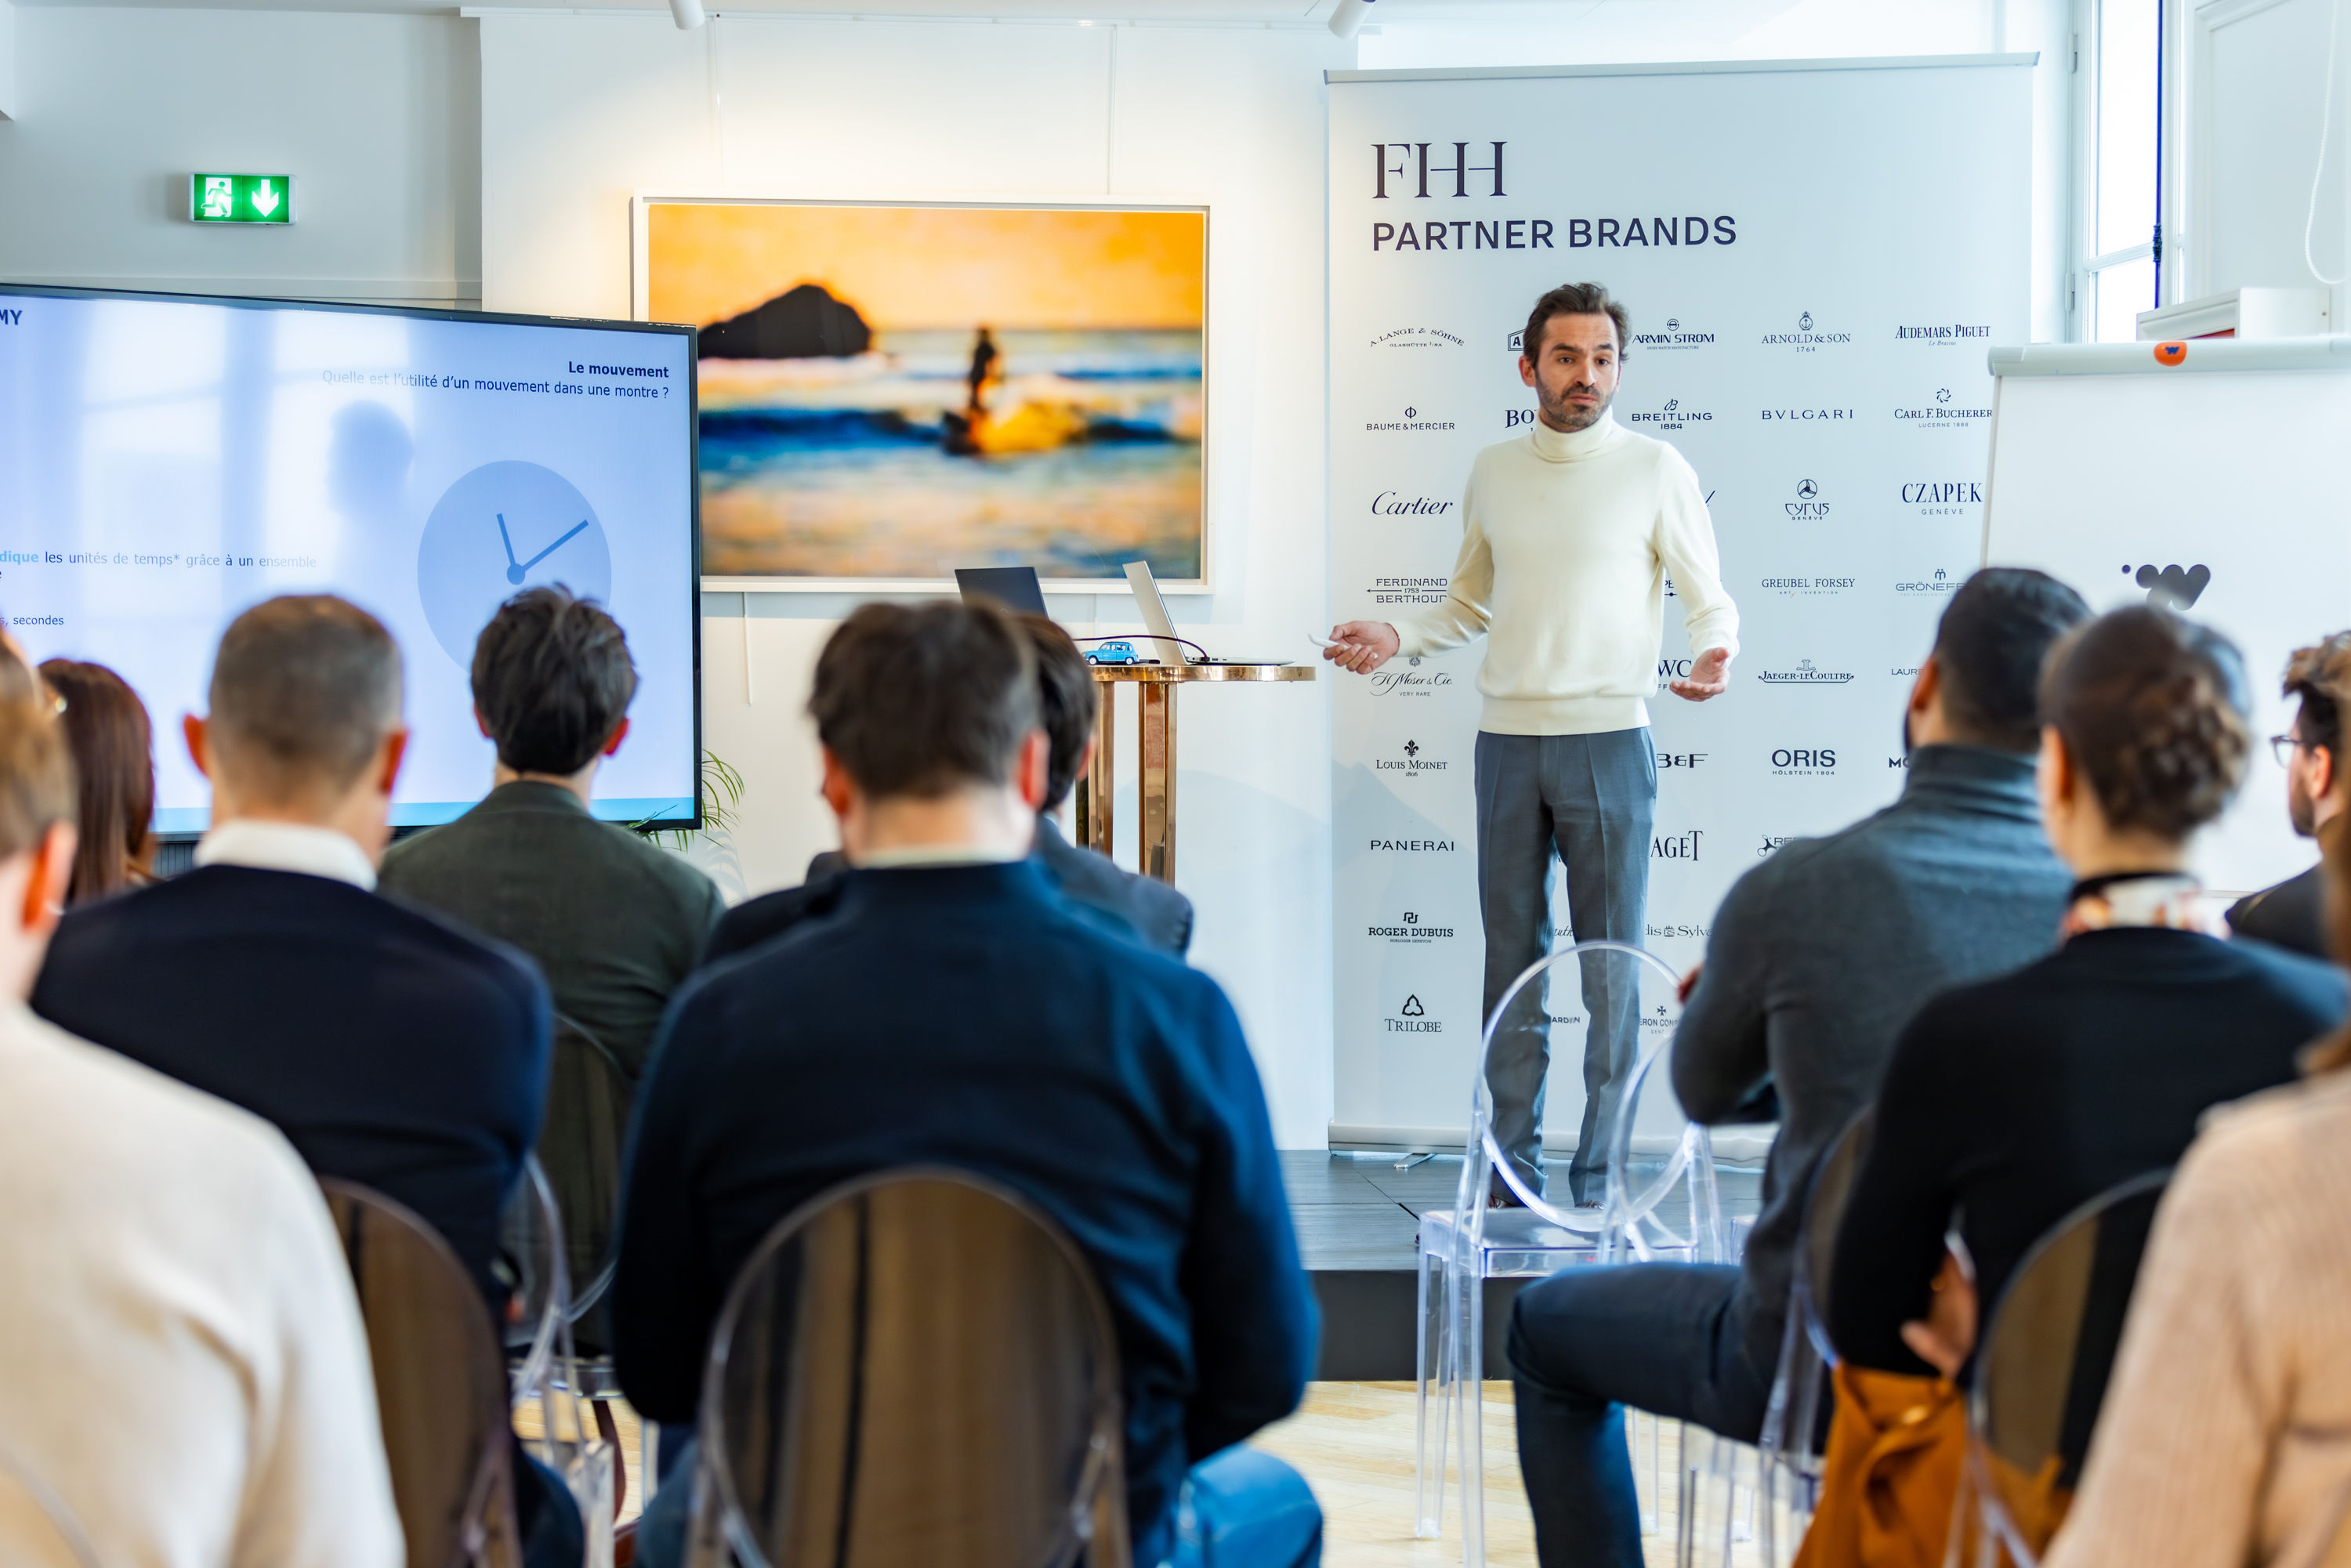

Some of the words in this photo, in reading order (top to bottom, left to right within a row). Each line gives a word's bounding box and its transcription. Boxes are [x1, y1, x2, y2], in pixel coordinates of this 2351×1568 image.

[1373, 219, 1555, 251] PARTNER
[1569, 215, 1737, 248] BRANDS
[1430, 329, 1465, 346] SÖHNE
[1632, 335, 1671, 343] ARMIN
[1675, 334, 1715, 343] STROM
[1895, 325, 1951, 339] AUDEMARS
[1954, 324, 1991, 337] PIGUET
[569, 361, 585, 374] Le
[589, 364, 669, 378] mouvement
[322, 370, 365, 384] Quelle
[369, 373, 389, 386] est
[474, 379, 550, 393] mouvement
[554, 382, 584, 395] dans
[588, 385, 610, 397] une
[615, 386, 659, 398] montre
[663, 387, 669, 399] ?
[1632, 413, 1712, 422] BREITLING
[1762, 409, 1853, 420] BVLGARI
[1894, 408, 1925, 418] CARL
[1925, 408, 1934, 418] F.
[1936, 408, 1993, 418] BUCHERER
[1902, 483, 1983, 503] CZAPEK
[1371, 491, 1453, 515] Cartier
[45, 552, 63, 563] les
[69, 552, 107, 563] unités
[114, 553, 128, 564] de
[187, 555, 220, 567] grâce
[226, 555, 233, 566] à
[239, 556, 253, 567] un
[259, 557, 317, 567] ensemble
[1762, 579, 1810, 588] GREUBEL
[1815, 579, 1855, 588] FORSEY
[13, 614, 63, 625] secondes
[1376, 760, 1405, 769] LOUIS
[1408, 760, 1447, 770] MOINET
[1772, 749, 1835, 767] ORIS
[1371, 840, 1454, 851] PANERAI
[1368, 927, 1408, 936] ROGER
[1411, 928, 1454, 937] DUBUIS
[1385, 1019, 1442, 1033] TRILOBE
